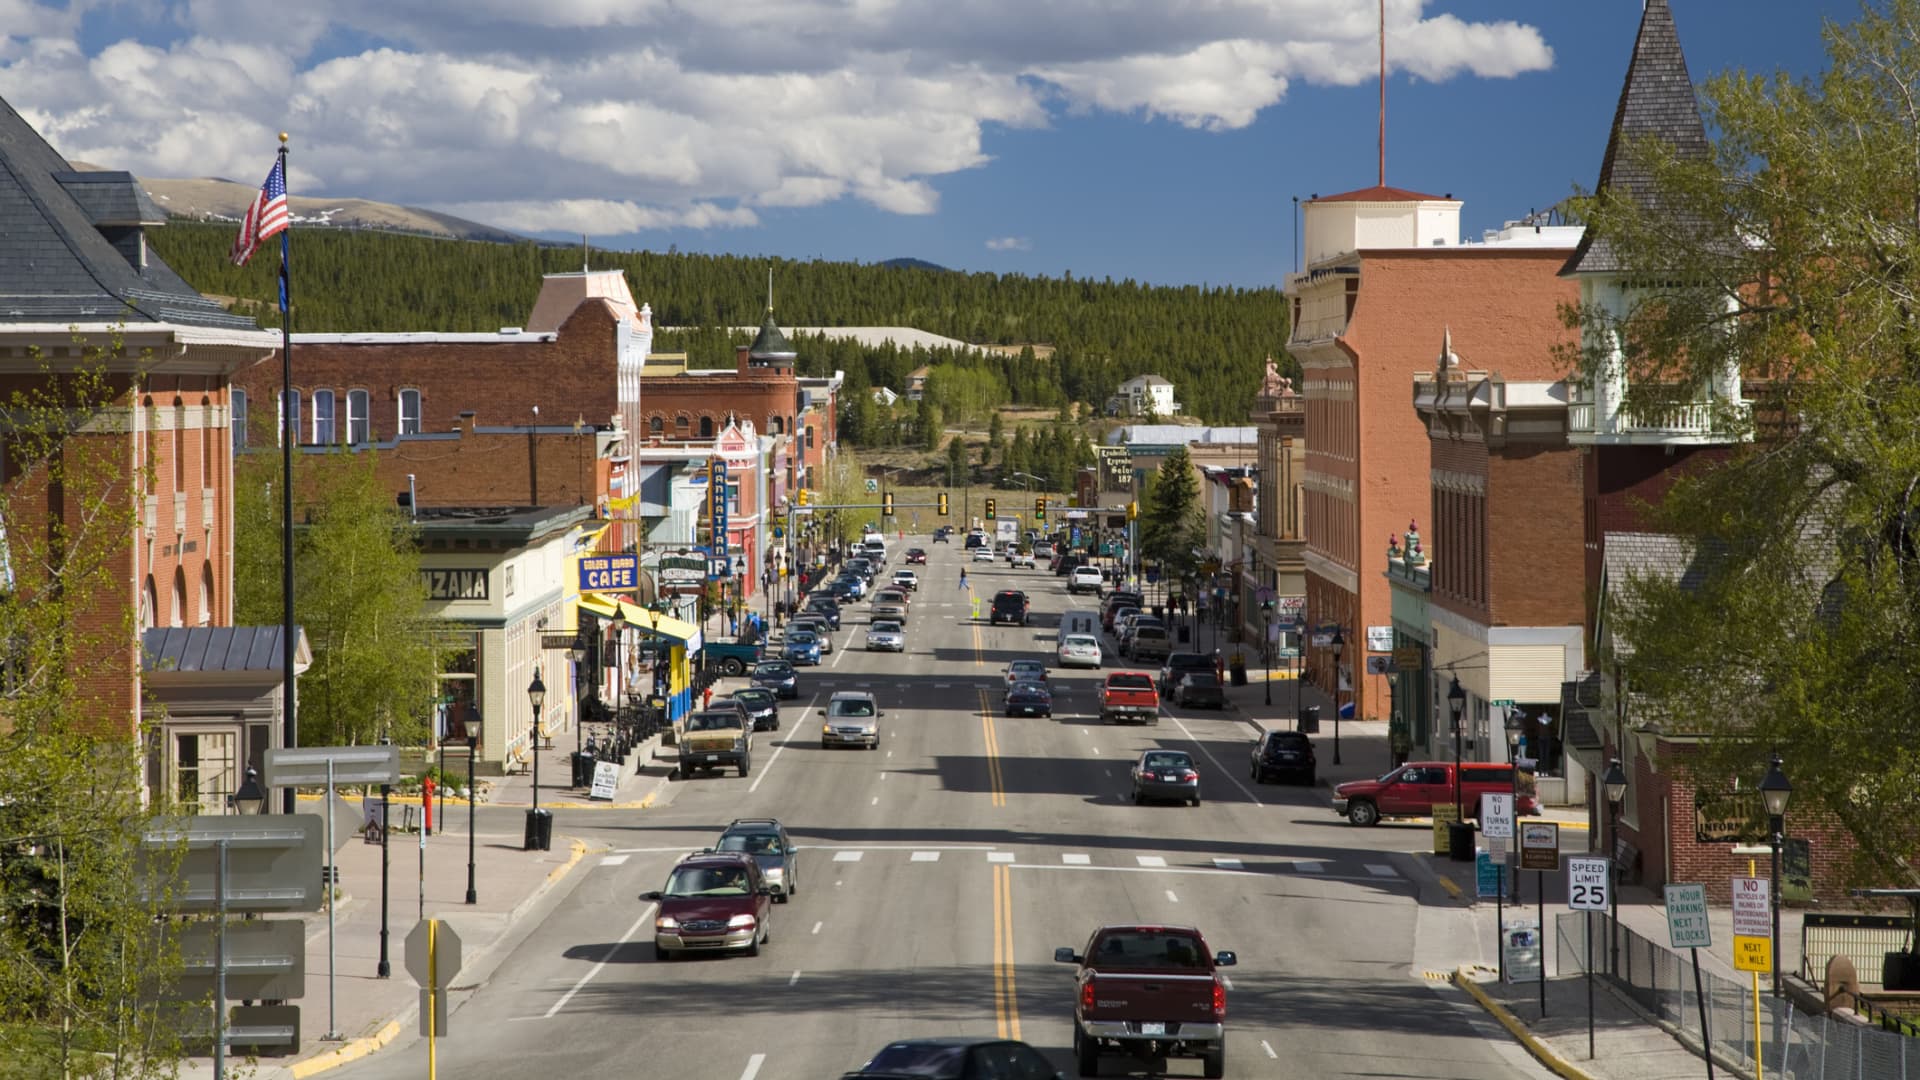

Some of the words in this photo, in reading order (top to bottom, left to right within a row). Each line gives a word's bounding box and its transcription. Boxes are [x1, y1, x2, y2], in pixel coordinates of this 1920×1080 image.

[714, 463, 725, 555] MANHATTAN
[588, 569, 632, 587] CAFE
[1494, 805, 1501, 815] U
[1487, 816, 1509, 825] TURNS
[1571, 863, 1605, 873] SPEED
[1575, 874, 1601, 884] LIMIT
[1743, 881, 1759, 892] NO
[1572, 885, 1605, 905] 25
[1669, 892, 1675, 902] 2
[1679, 890, 1700, 900] HOUR
[1670, 903, 1704, 914] PARKING
[1673, 918, 1692, 928] NEXT
[1697, 917, 1703, 927] 7
[1675, 931, 1706, 941] BLOCKS
[1743, 943, 1761, 953] NEXT
[1749, 955, 1765, 965] MILE
